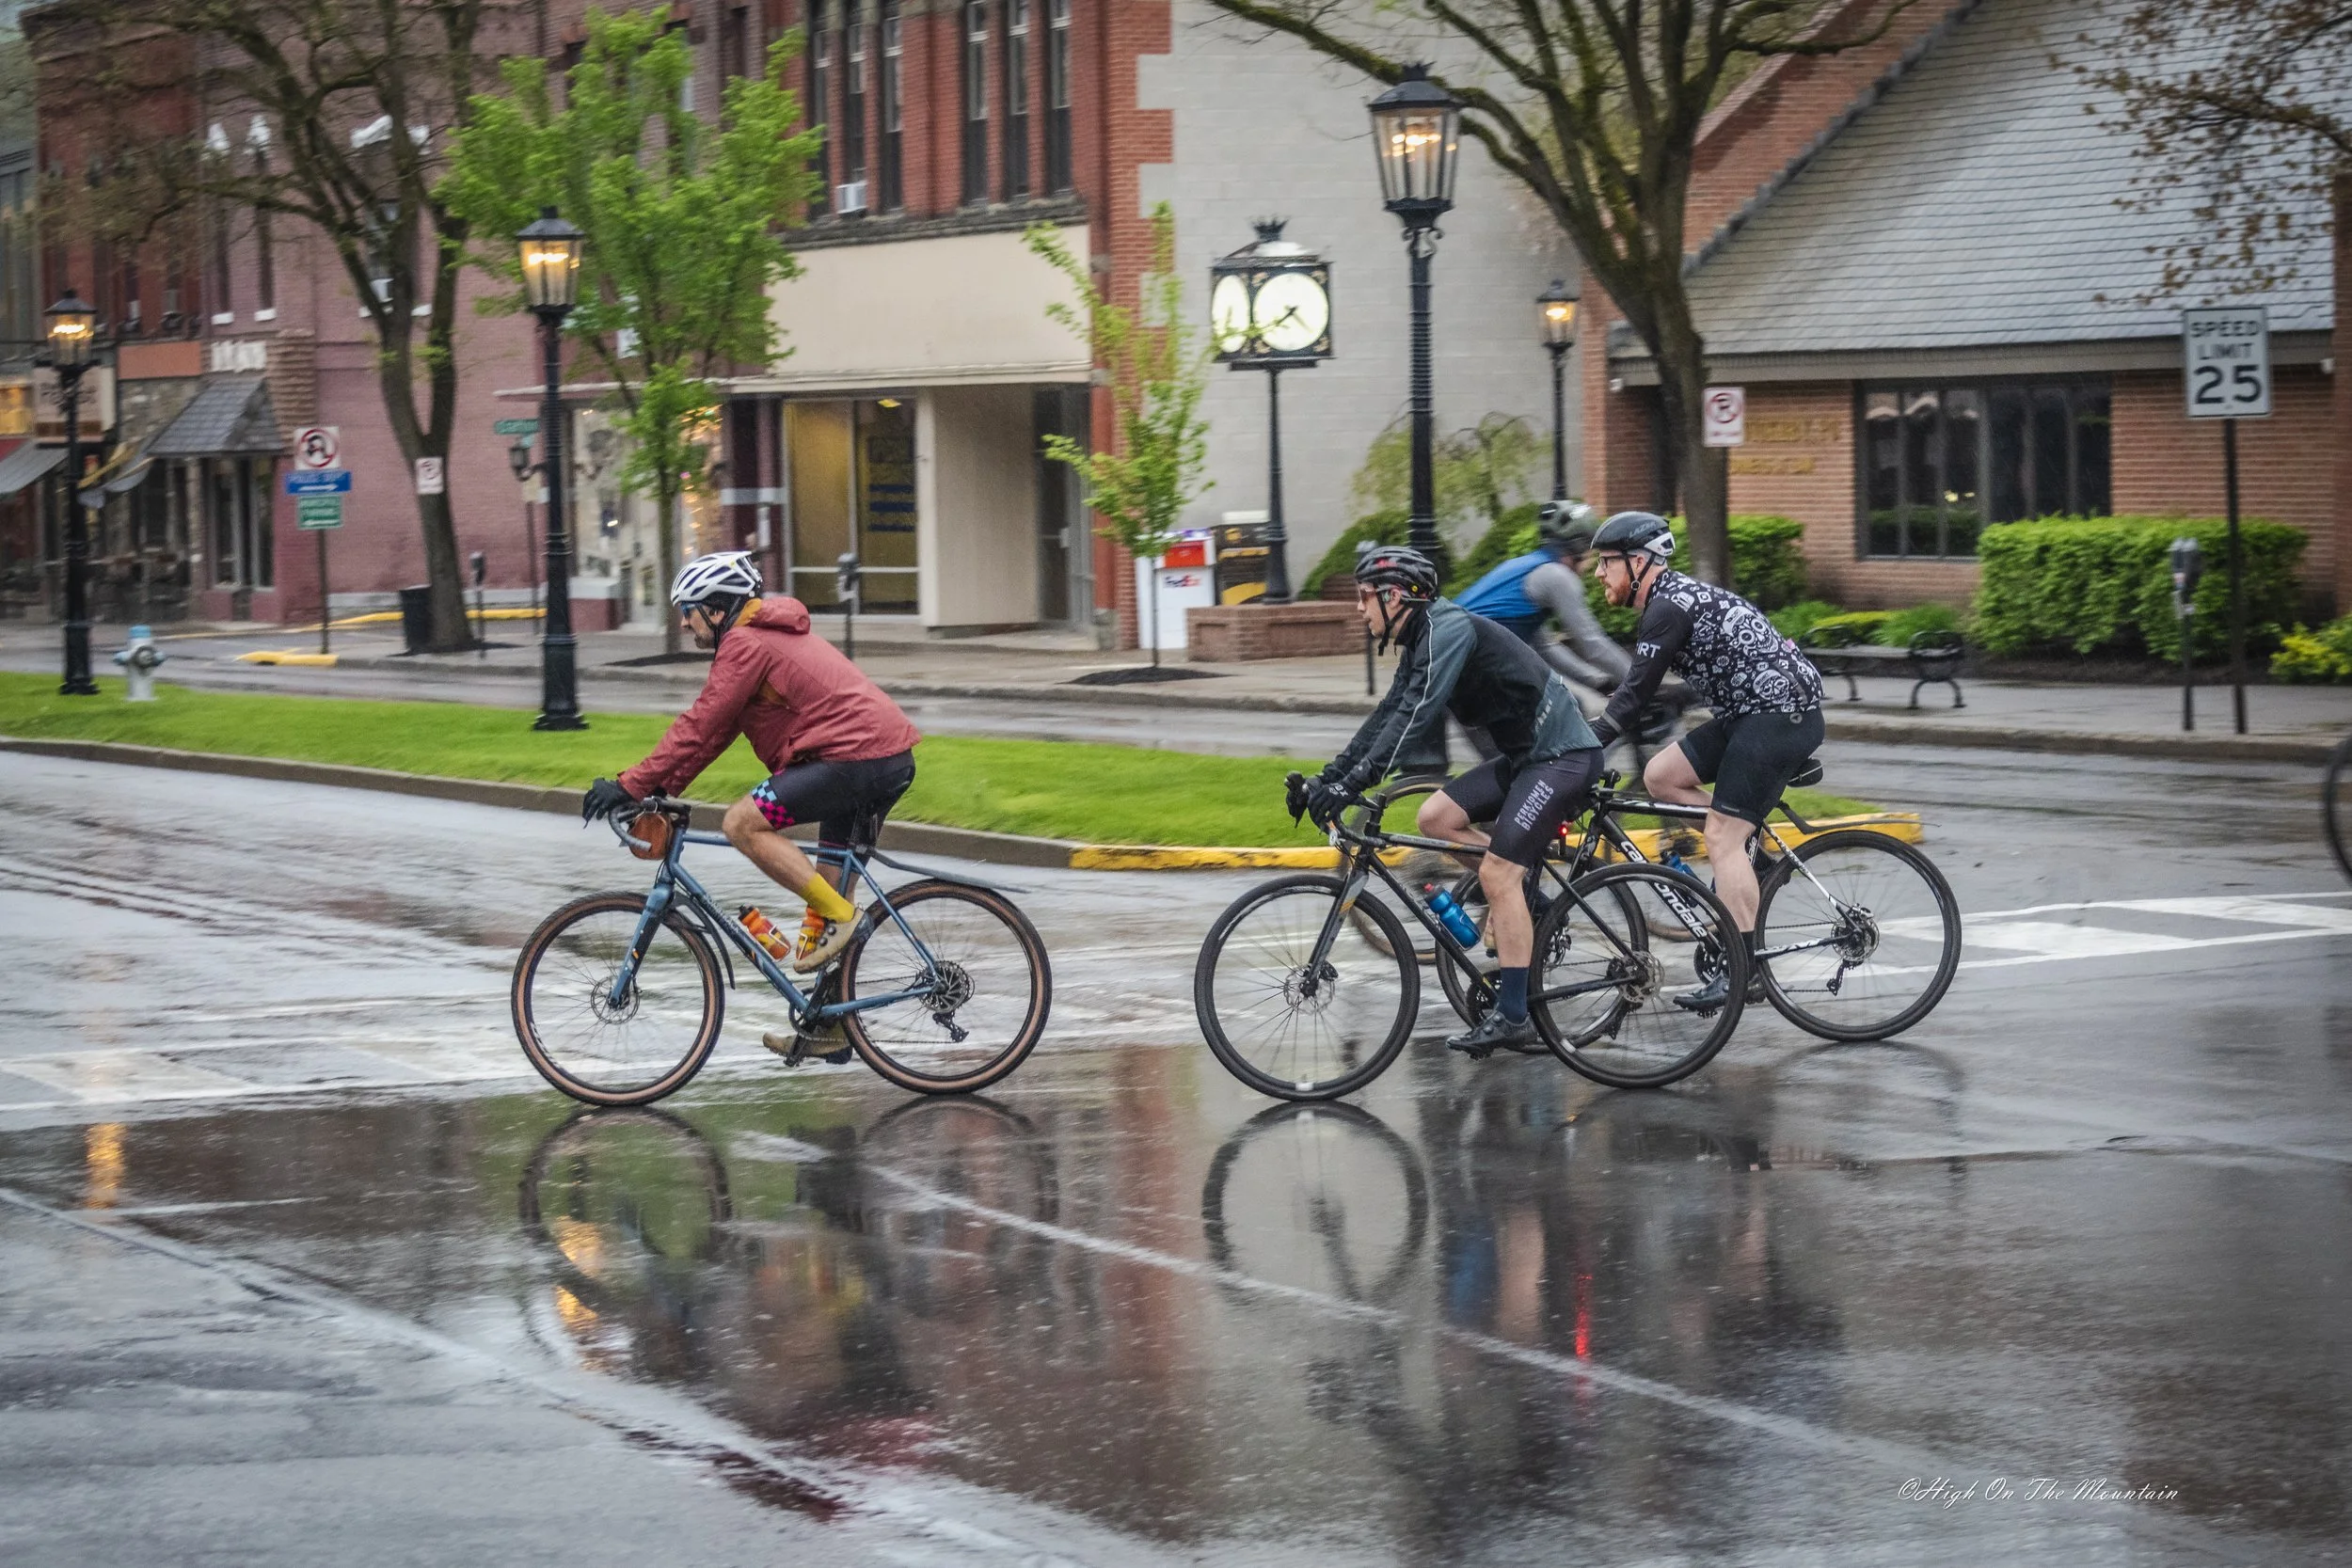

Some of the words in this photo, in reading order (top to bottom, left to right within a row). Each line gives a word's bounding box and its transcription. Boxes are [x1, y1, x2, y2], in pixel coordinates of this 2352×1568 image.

[2190, 320, 2258, 338] SPEED
[2197, 342, 2255, 360] LIMIT
[2193, 364, 2263, 404] 25
[1514, 779, 1547, 826] PERKIOMEN
[1520, 785, 1554, 832] BICYCLES
